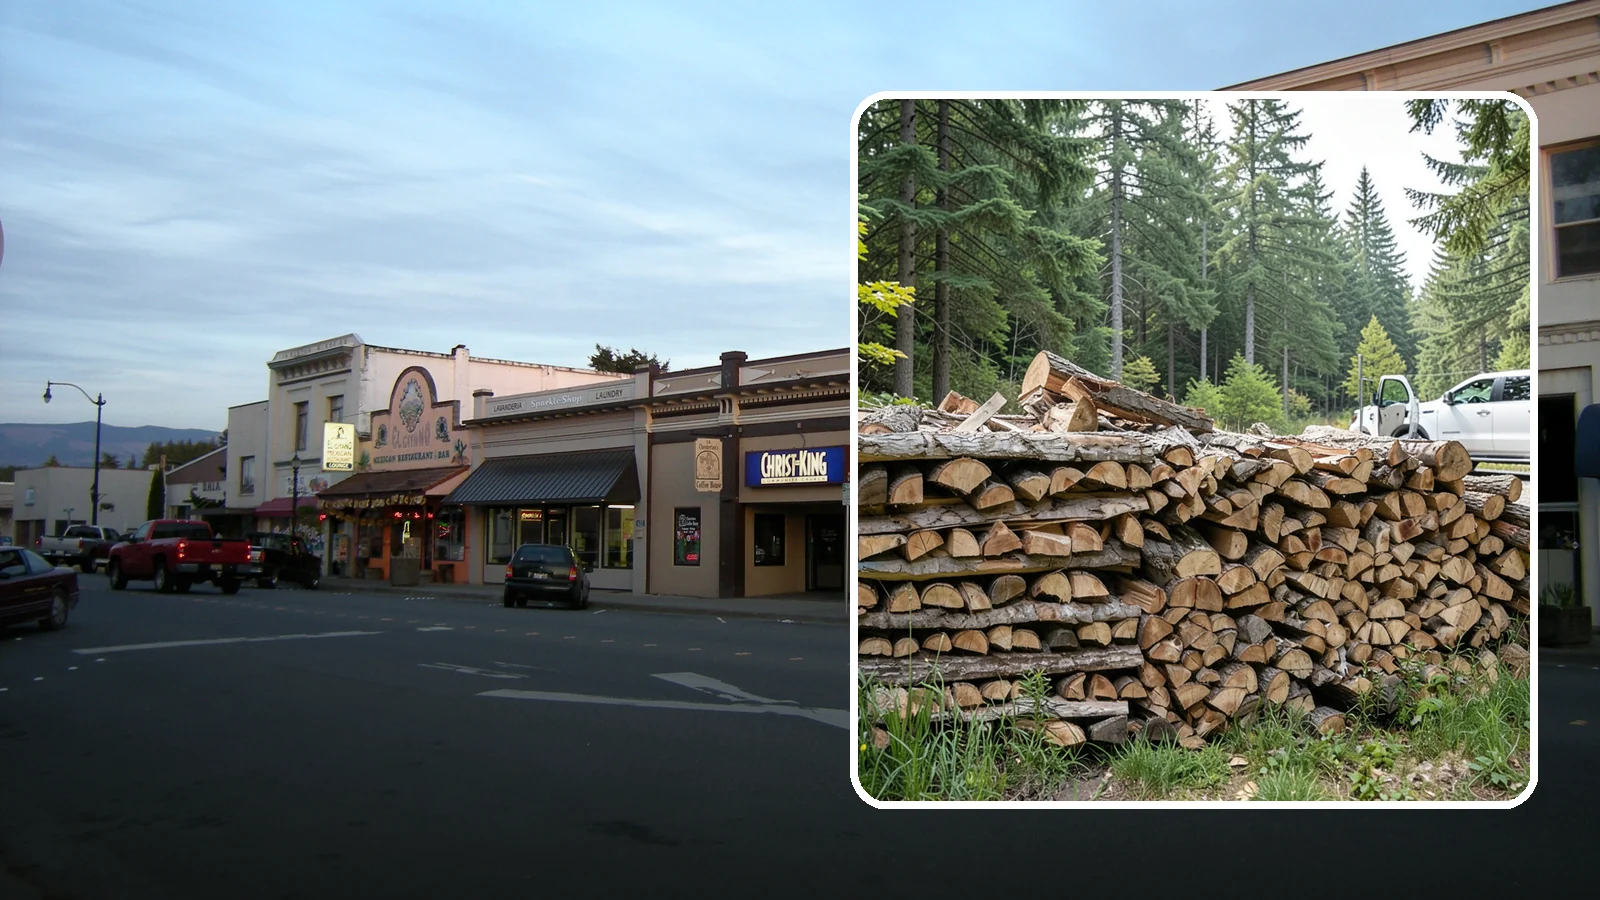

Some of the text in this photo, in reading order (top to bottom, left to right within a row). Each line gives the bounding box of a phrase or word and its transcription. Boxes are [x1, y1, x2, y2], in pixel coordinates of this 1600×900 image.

[531, 394, 582, 409] Sparkle Shop
[595, 389, 624, 400] LAUNDRY
[493, 402, 523, 413] LAVANDERIA
[374, 455, 396, 464] MEXICAN
[398, 451, 433, 462] RESTAURANT
[438, 450, 450, 458] BAR
[761, 450, 827, 478] CHRIST KING
